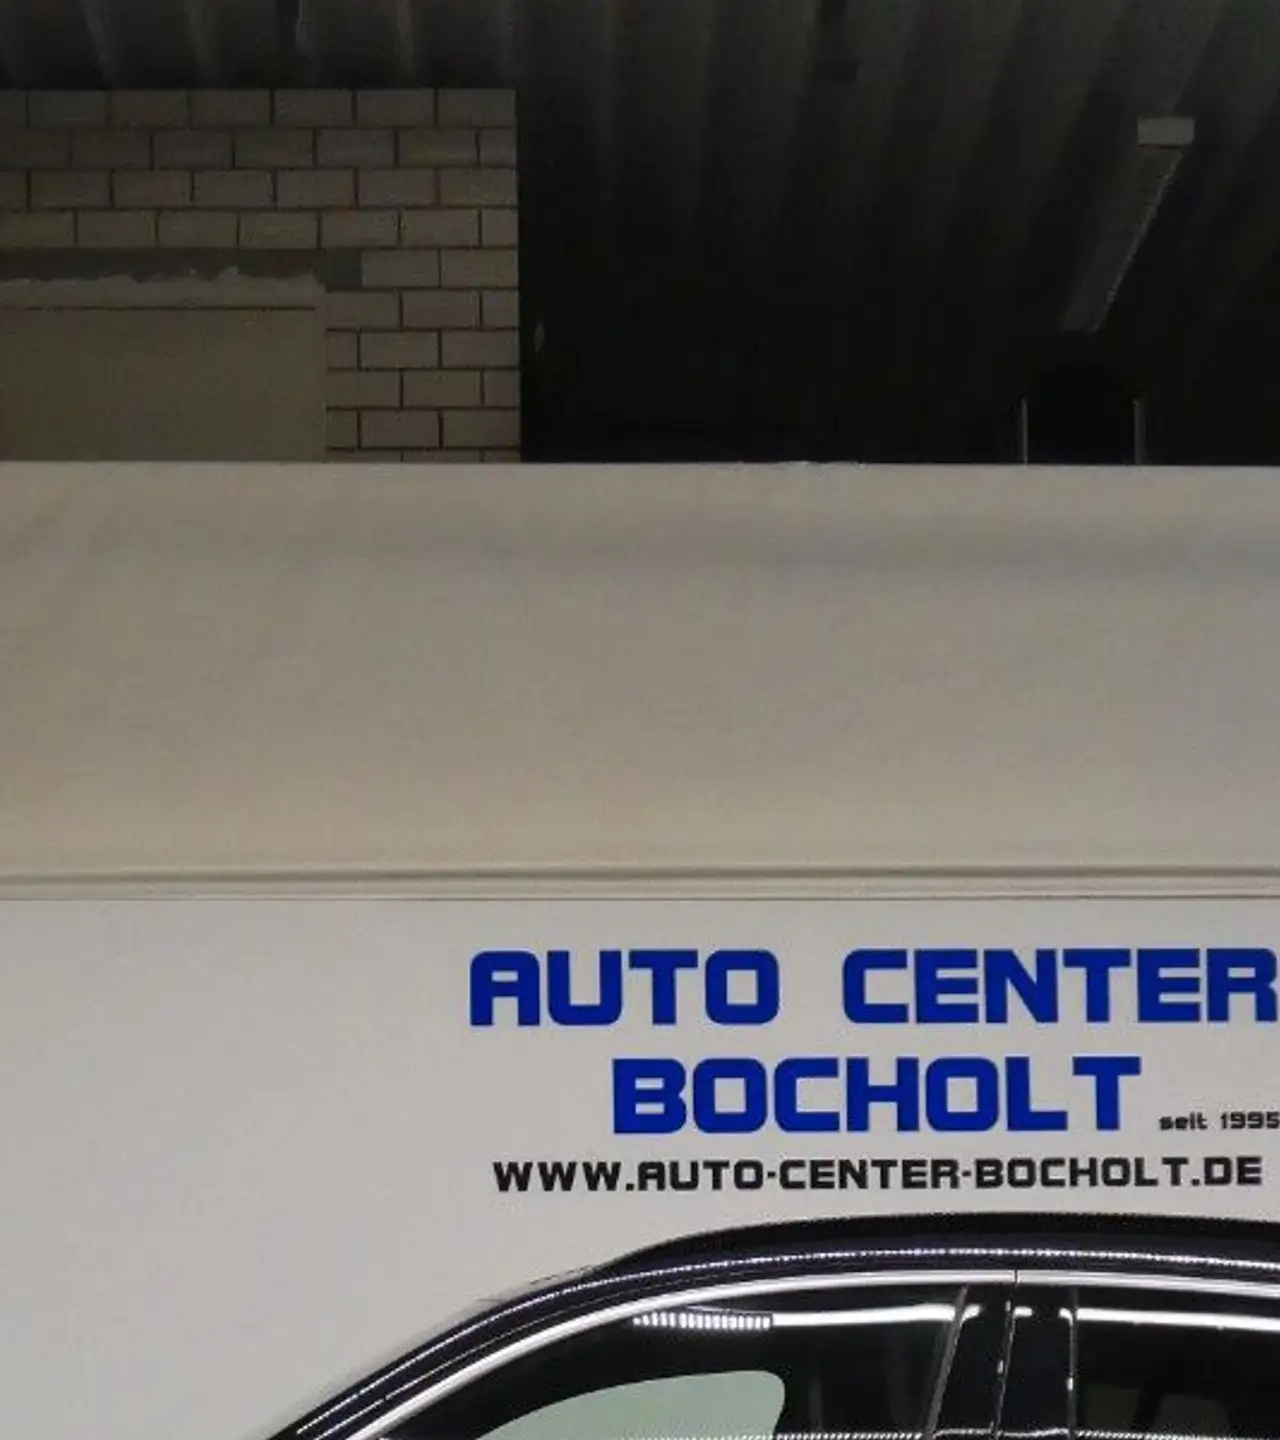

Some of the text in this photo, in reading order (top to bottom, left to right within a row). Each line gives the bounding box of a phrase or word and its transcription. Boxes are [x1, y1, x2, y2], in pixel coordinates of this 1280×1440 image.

[470, 948, 1278, 1027] AUTO CENTER
[612, 1055, 1280, 1135] BOCHOLT seit 1995
[492, 1155, 1263, 1193] WWW.AUTO-CENTER-BOCHOLT.DE
